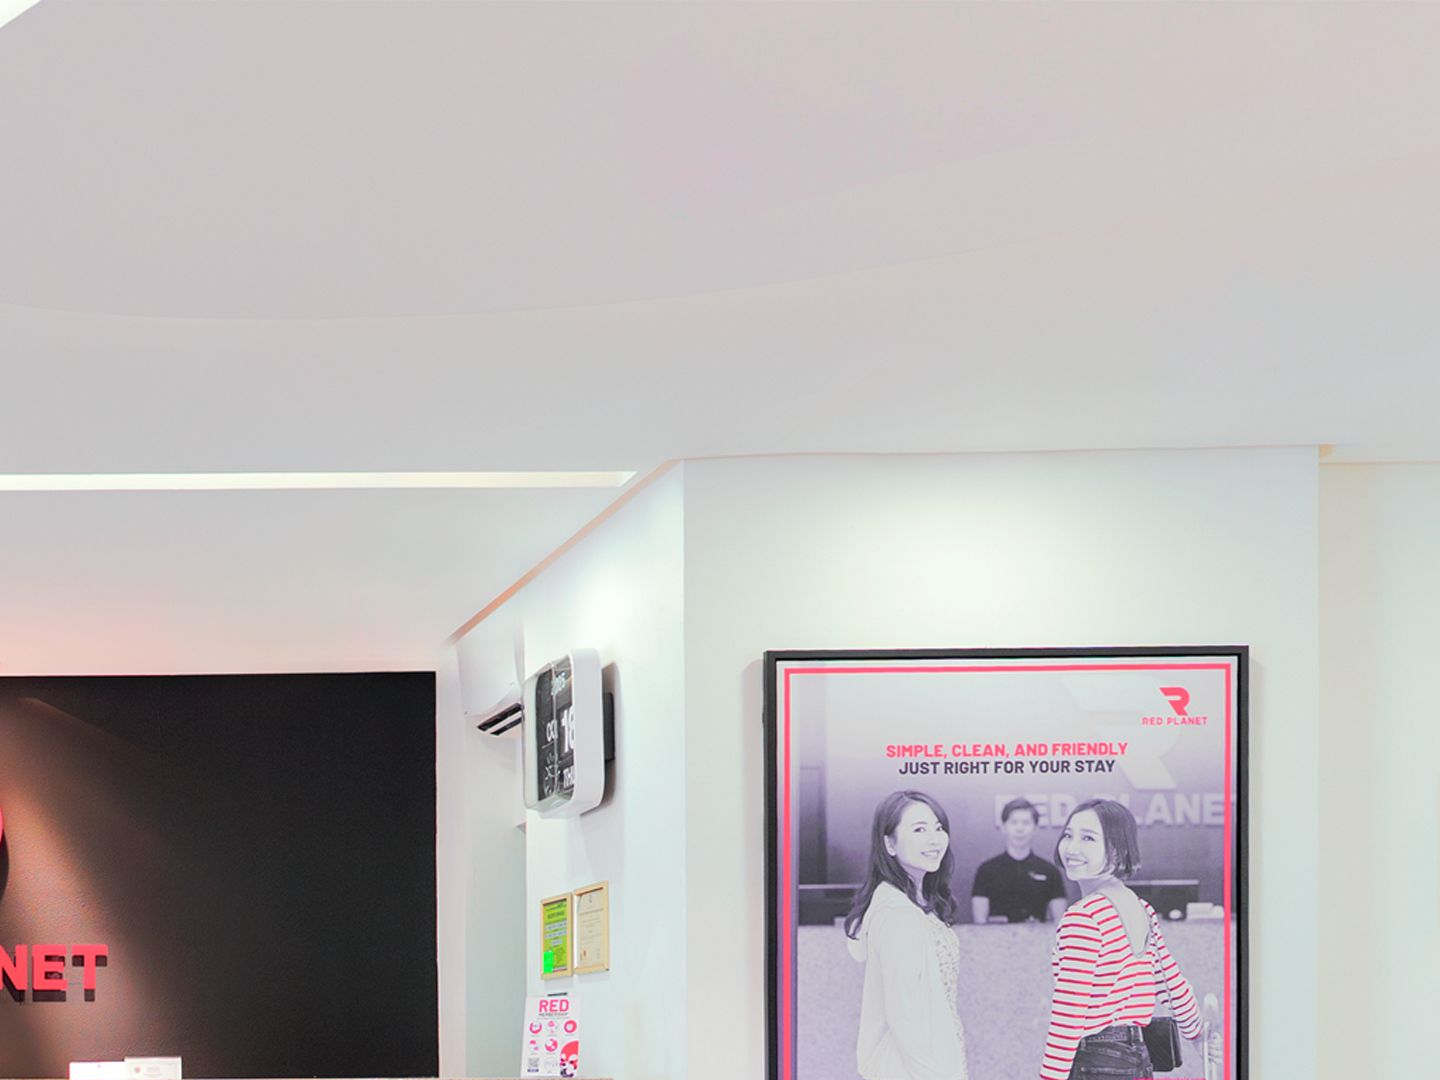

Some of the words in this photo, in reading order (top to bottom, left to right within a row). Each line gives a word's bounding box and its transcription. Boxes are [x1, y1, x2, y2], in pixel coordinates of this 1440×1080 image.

[1142, 717, 1163, 726] RED
[1167, 716, 1208, 726] PLANET
[886, 744, 948, 758] SIMPLE,
[952, 743, 1010, 758] CLEAN,
[1014, 743, 1048, 757] AND
[1052, 742, 1128, 756] FRIENDLY
[899, 762, 940, 775] JUST
[944, 761, 989, 774] RIGHT
[994, 761, 1025, 774] FOR
[1029, 761, 1070, 774] YOUR
[1075, 760, 1116, 773] STAY
[538, 999, 570, 1013] RED
